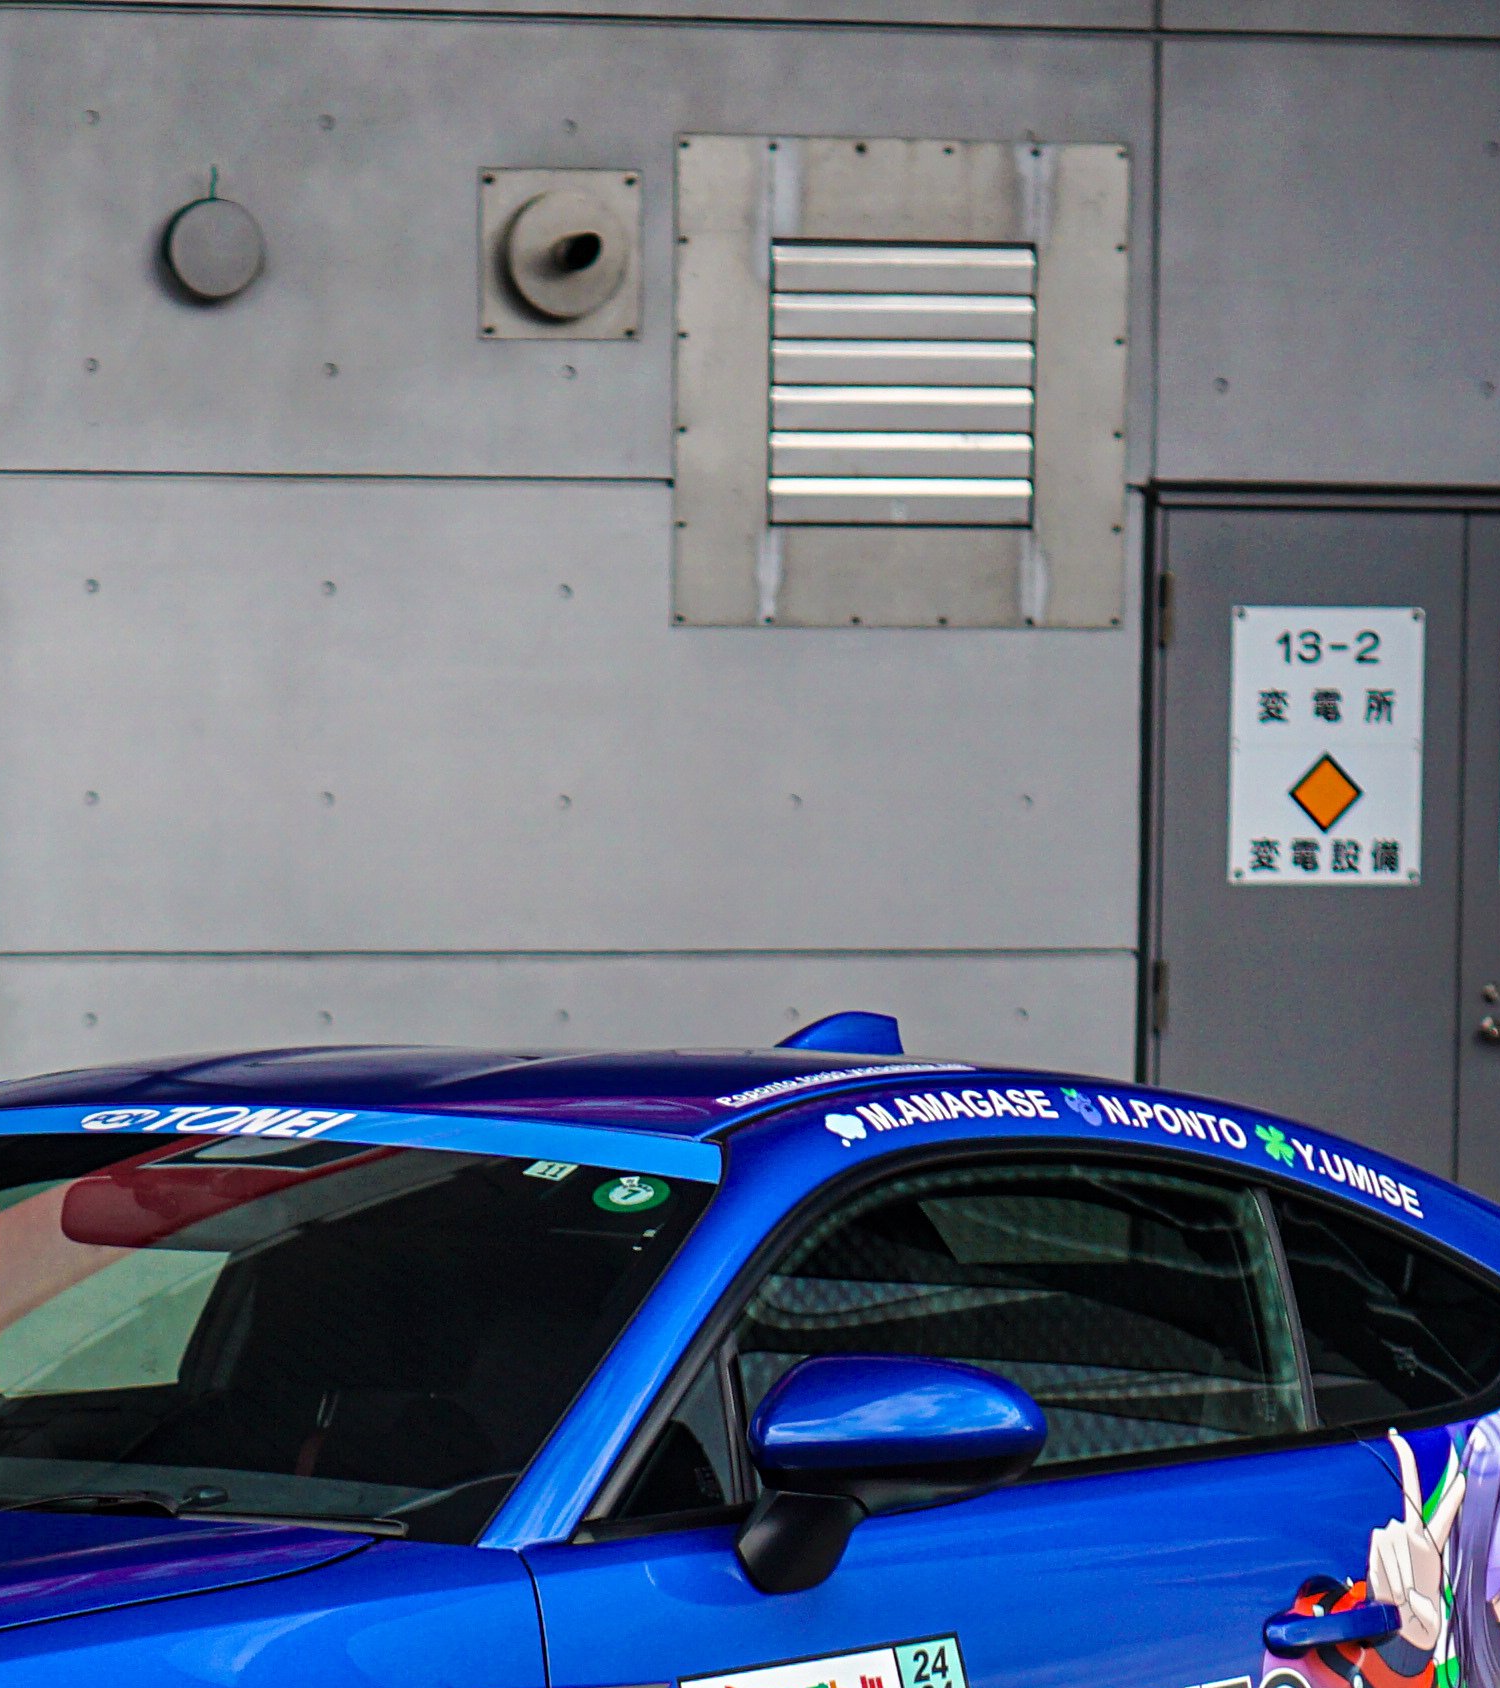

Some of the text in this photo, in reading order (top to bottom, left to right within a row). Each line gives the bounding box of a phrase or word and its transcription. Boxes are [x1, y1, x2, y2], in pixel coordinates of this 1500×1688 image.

[1275, 629, 1383, 665] 13-2
[1248, 837, 1401, 875] 変電設備
[860, 1087, 1060, 1134] M.AMAGASE
[1096, 1094, 1248, 1150] N.PONTO
[1290, 1138, 1426, 1220] Y.UMISE
[912, 1646, 949, 1683] 24
